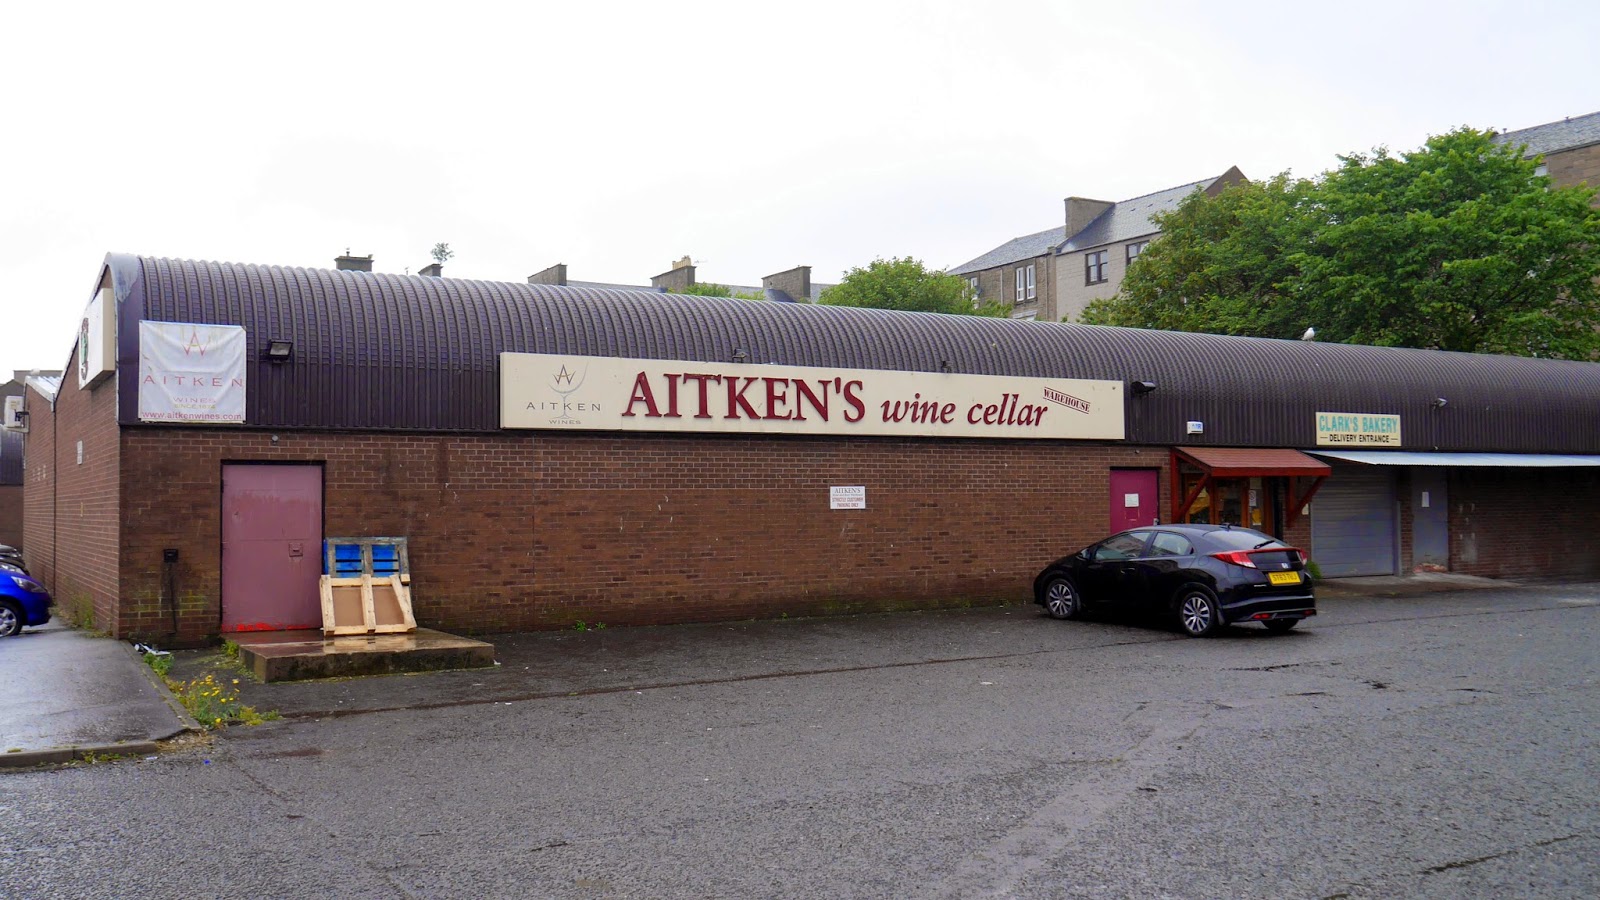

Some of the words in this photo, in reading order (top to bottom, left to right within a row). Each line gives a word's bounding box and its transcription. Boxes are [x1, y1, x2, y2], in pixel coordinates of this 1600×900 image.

[143, 374, 243, 387] AITKEN
[621, 370, 866, 423] AITKEN'S
[880, 392, 957, 425] wine
[966, 393, 1049, 427] cellar
[1043, 388, 1091, 412] WAREHOUSE
[526, 401, 601, 412] AITKEN
[141, 411, 242, 420] www.aitkenwines.com
[1319, 415, 1359, 432] CLARK'S
[1362, 416, 1398, 433] BAKERY
[1329, 433, 1357, 442] DELIVERY
[1359, 434, 1390, 443] ENTRANCE
